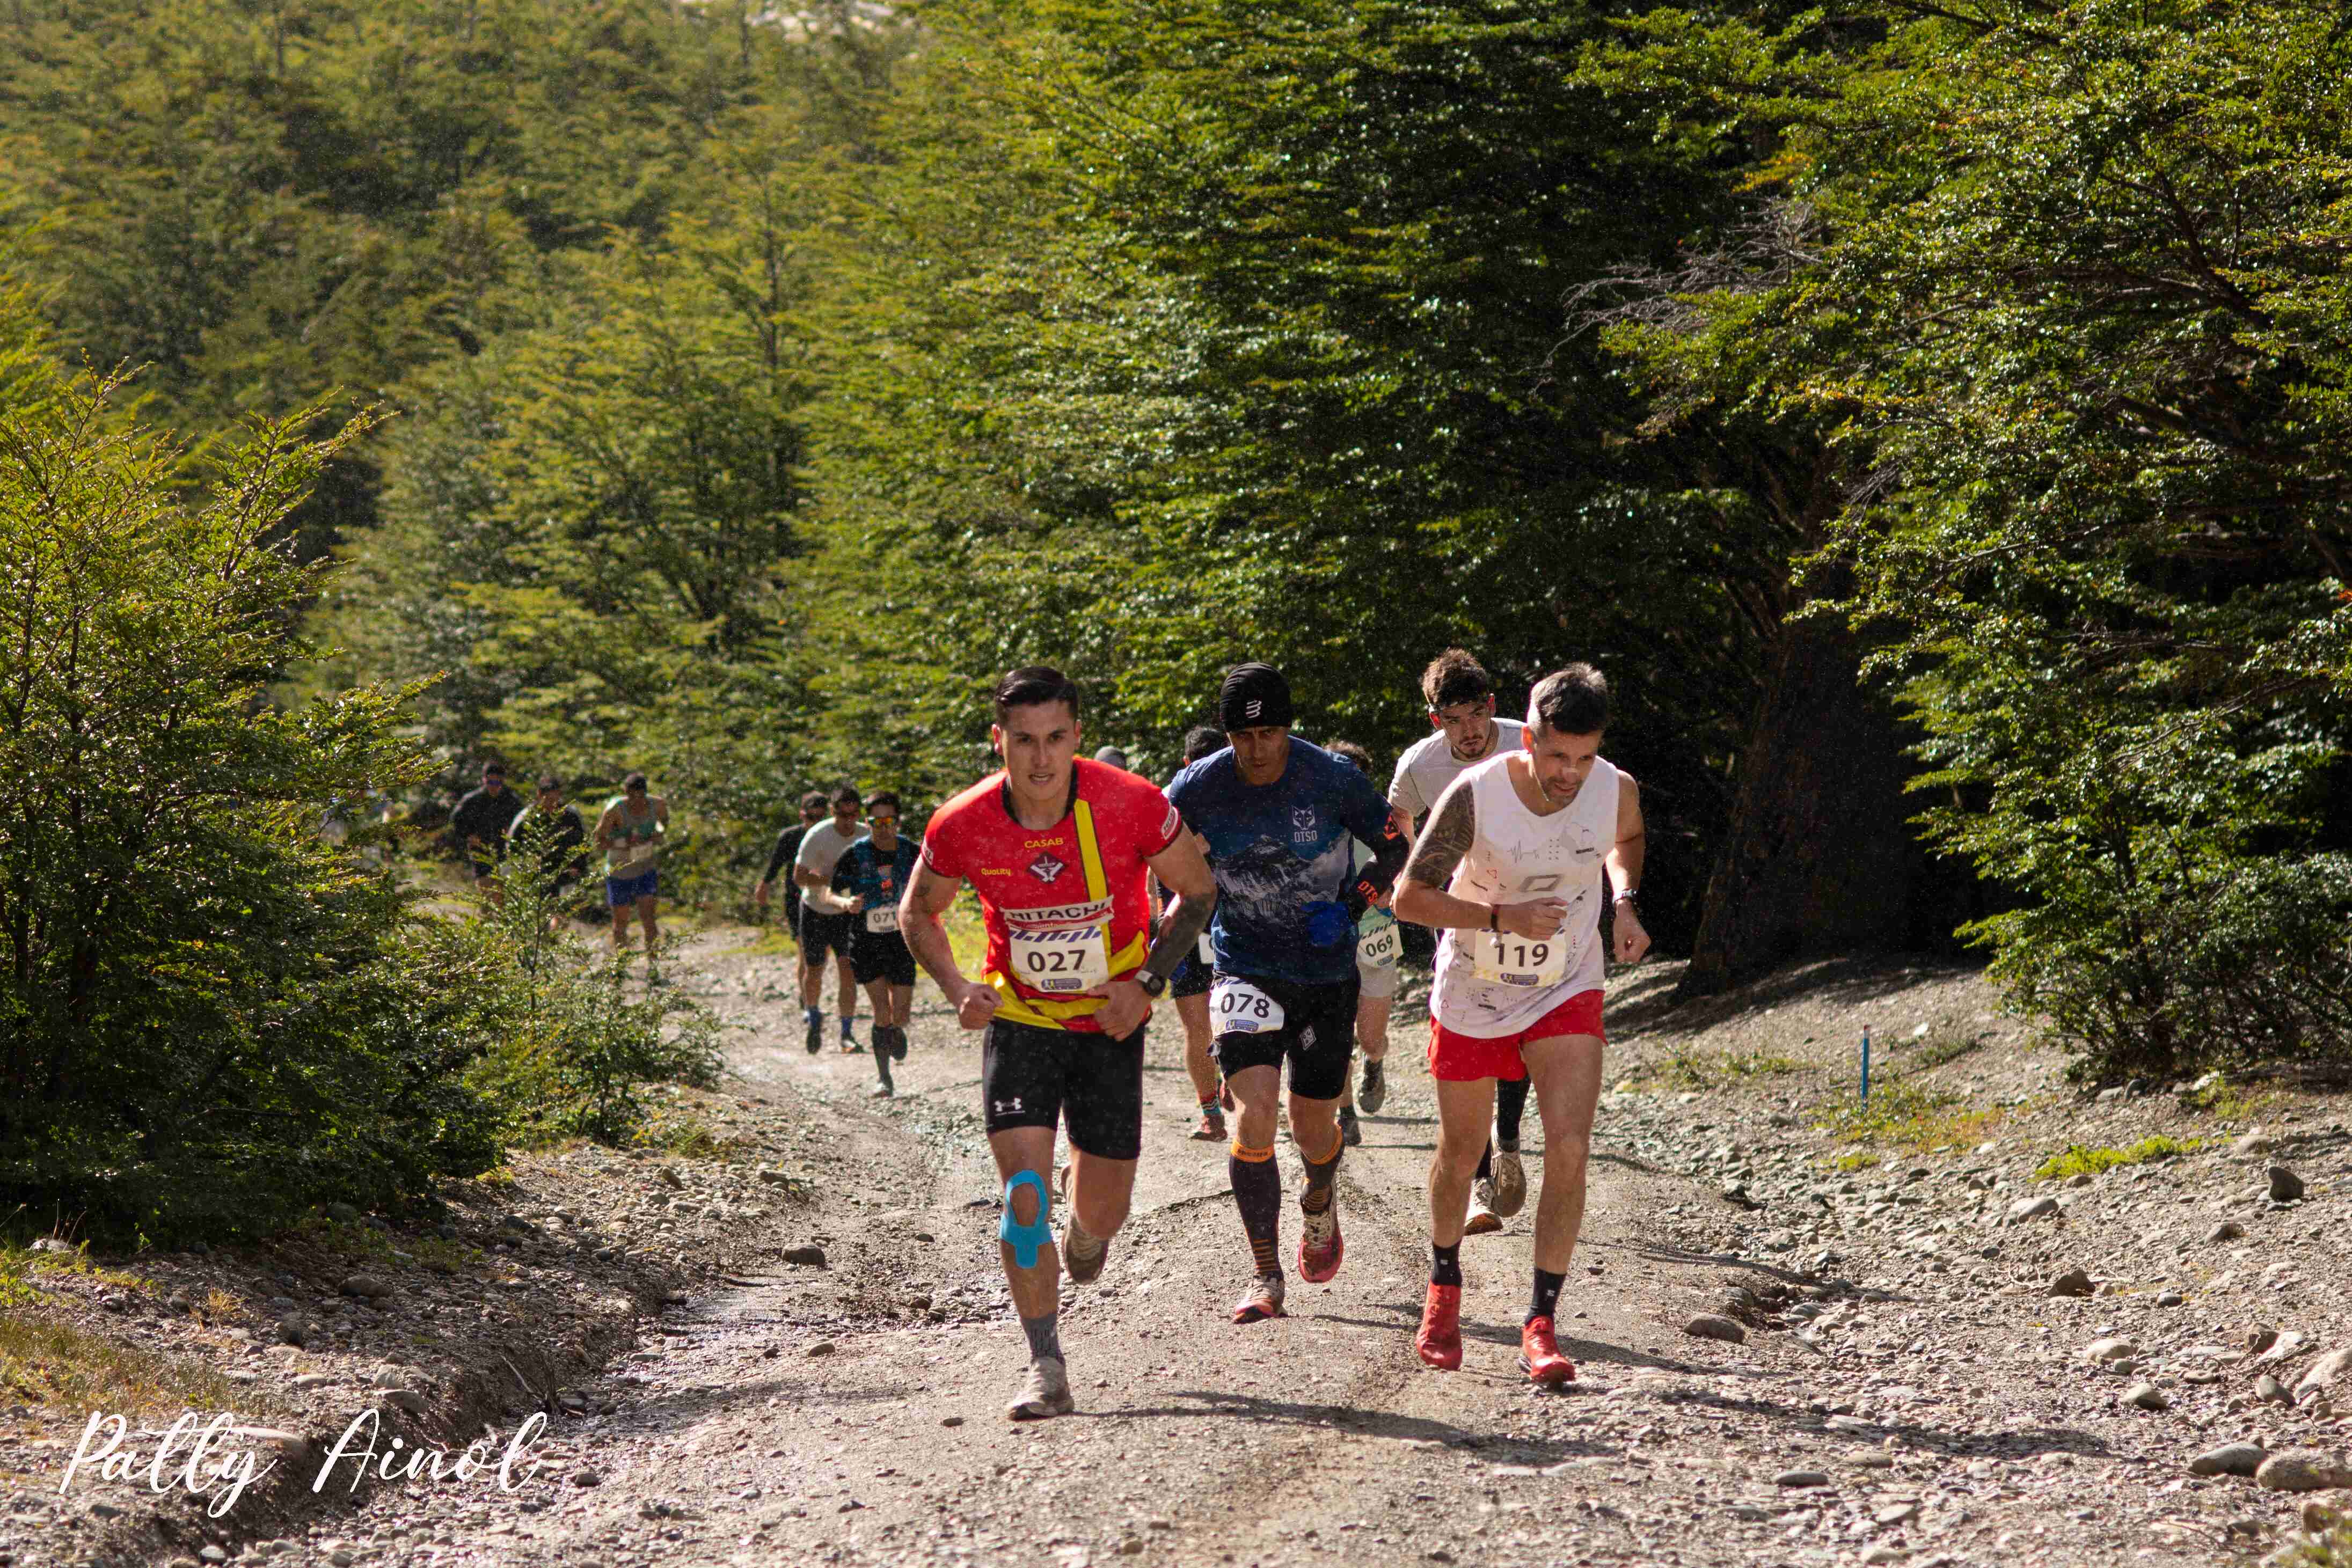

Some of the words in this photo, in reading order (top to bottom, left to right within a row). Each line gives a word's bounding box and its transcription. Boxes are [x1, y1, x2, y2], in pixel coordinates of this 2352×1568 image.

[1024, 837, 1064, 848] CASAB
[1294, 830, 1318, 842] OTSO
[1365, 934, 1393, 957] 069
[1494, 943, 1549, 967] 119
[1027, 949, 1086, 973] 027
[1220, 993, 1270, 1019] 078
